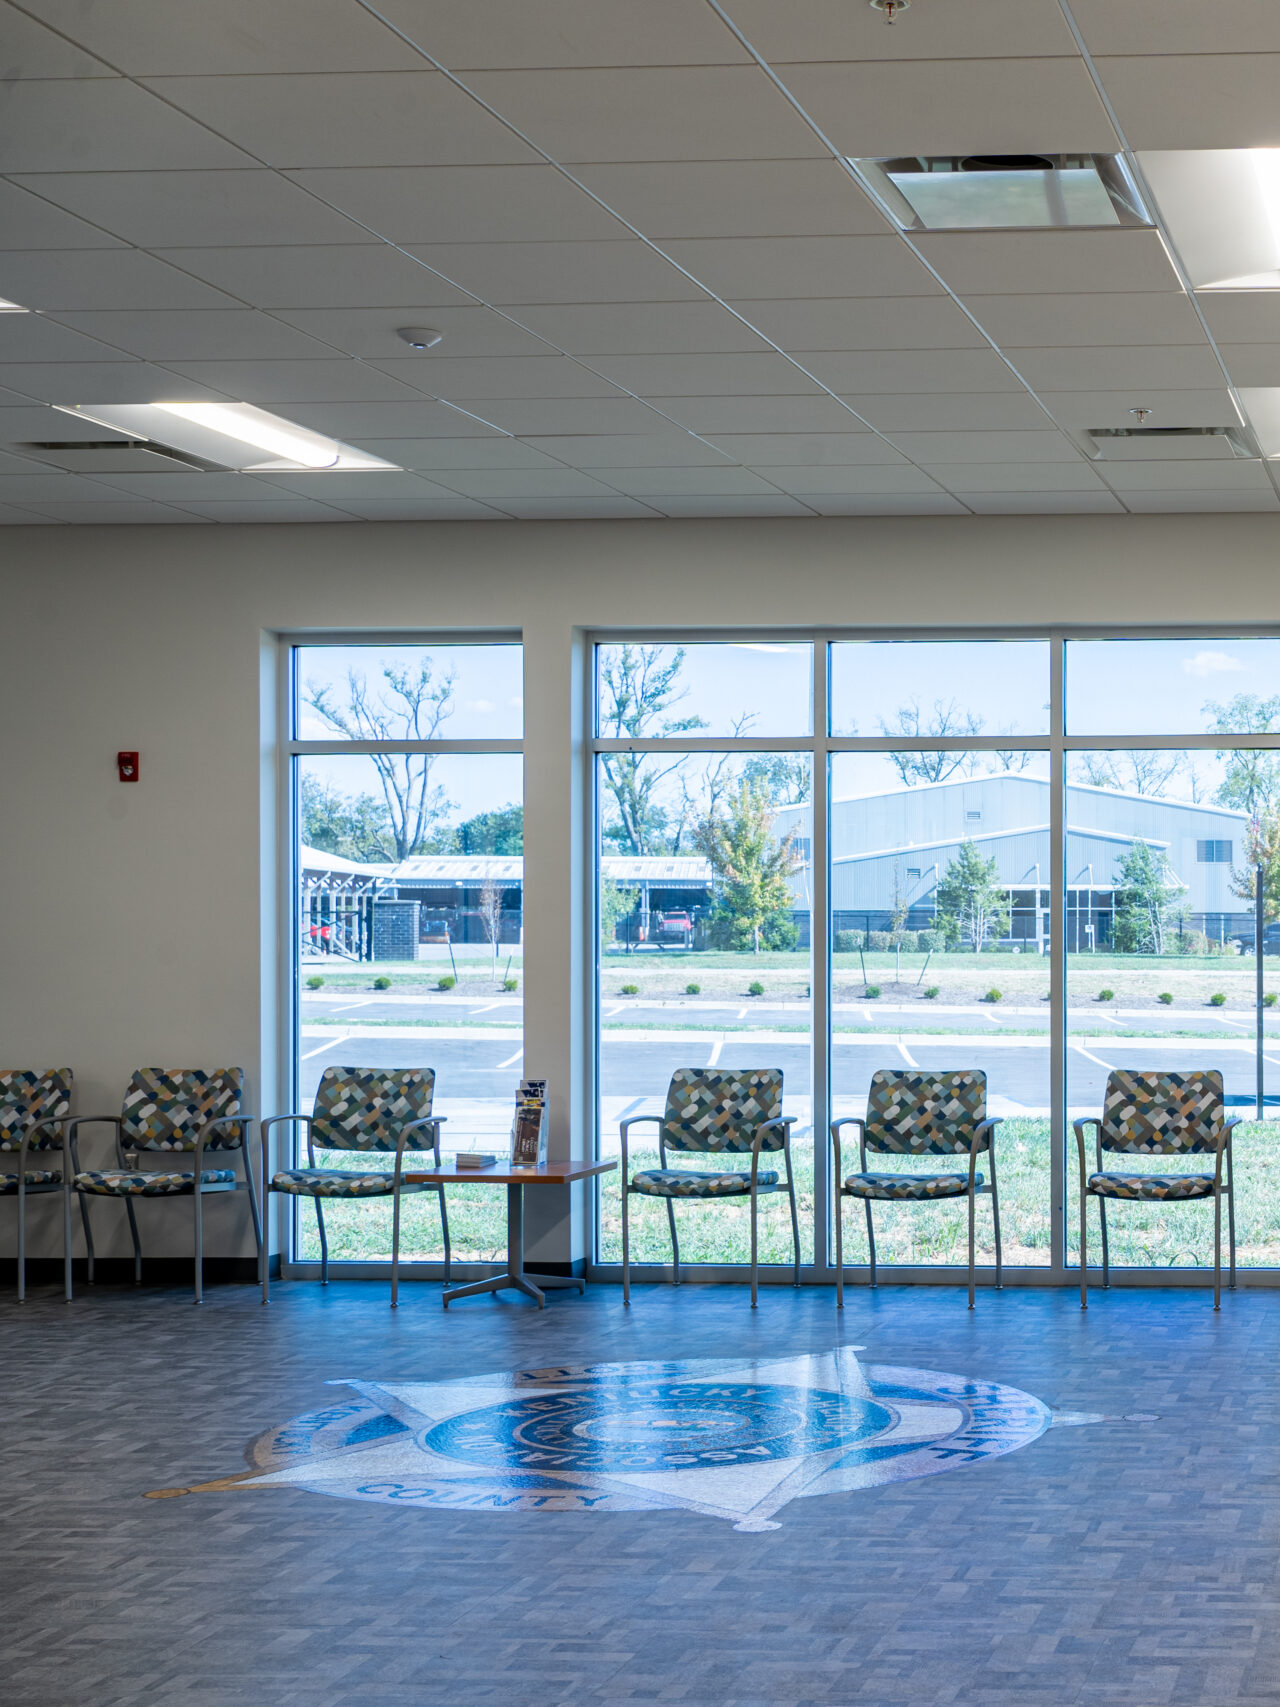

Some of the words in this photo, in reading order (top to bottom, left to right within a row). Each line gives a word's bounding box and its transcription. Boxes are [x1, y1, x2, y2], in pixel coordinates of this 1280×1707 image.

[520, 1362, 690, 1381] SCOTT
[494, 1386, 775, 1418] KENTUCKY
[927, 1384, 1040, 1462] SHERIFF
[355, 1482, 613, 1508] COUNTY
